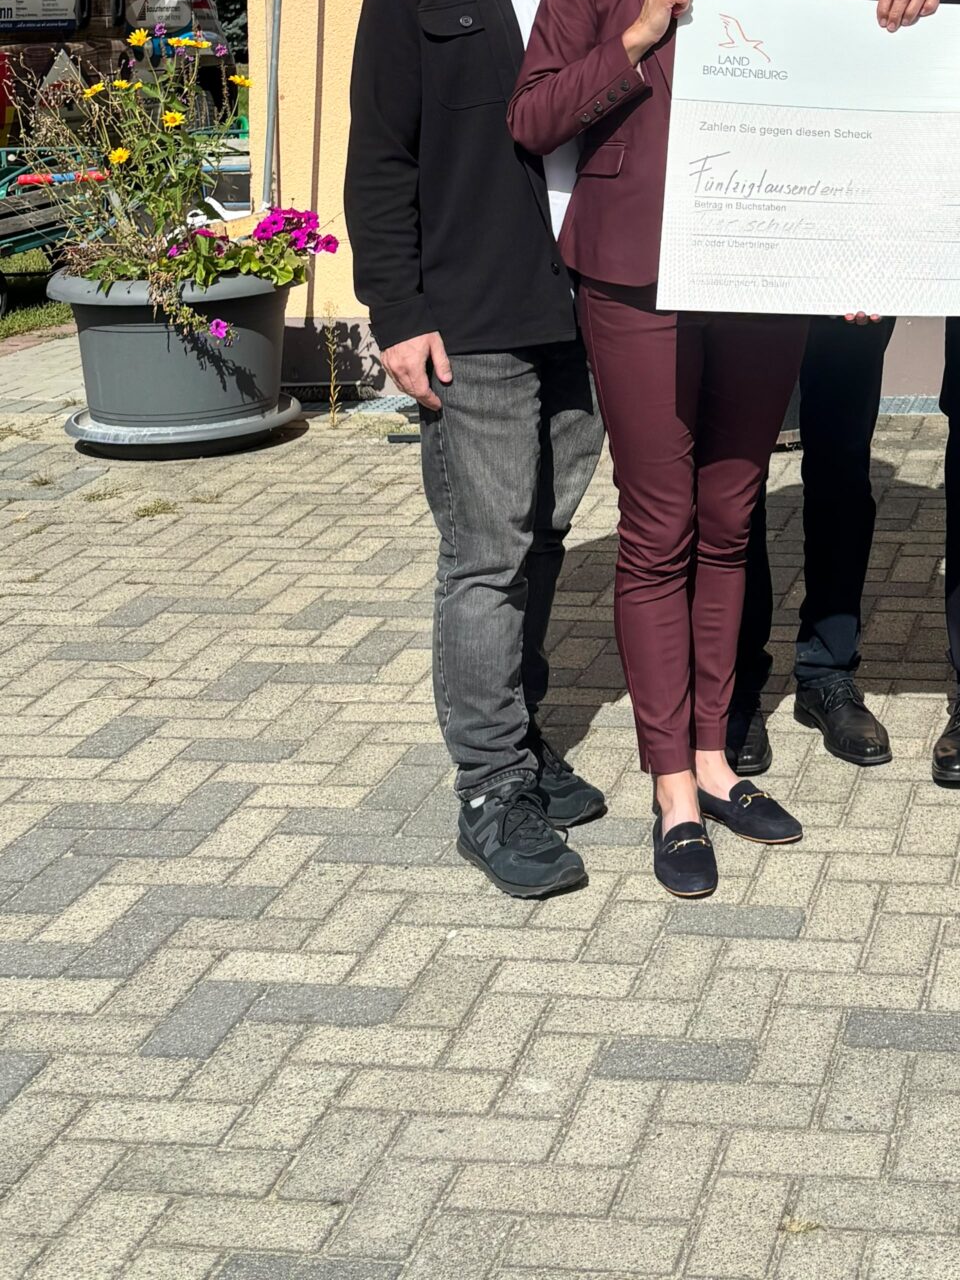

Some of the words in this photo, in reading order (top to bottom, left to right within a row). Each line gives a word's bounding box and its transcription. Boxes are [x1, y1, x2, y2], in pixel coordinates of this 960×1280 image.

[718, 55, 750, 67] LAND
[702, 65, 788, 81] BRANDENBURG
[699, 121, 737, 133] Zahlen
[739, 123, 757, 134] Sie
[759, 126, 793, 137] gegen
[795, 127, 831, 138] diesen
[833, 128, 873, 140] Scheck
[694, 200, 723, 211] Betrag
[725, 201, 733, 210] in
[735, 201, 787, 212] Buchstaben
